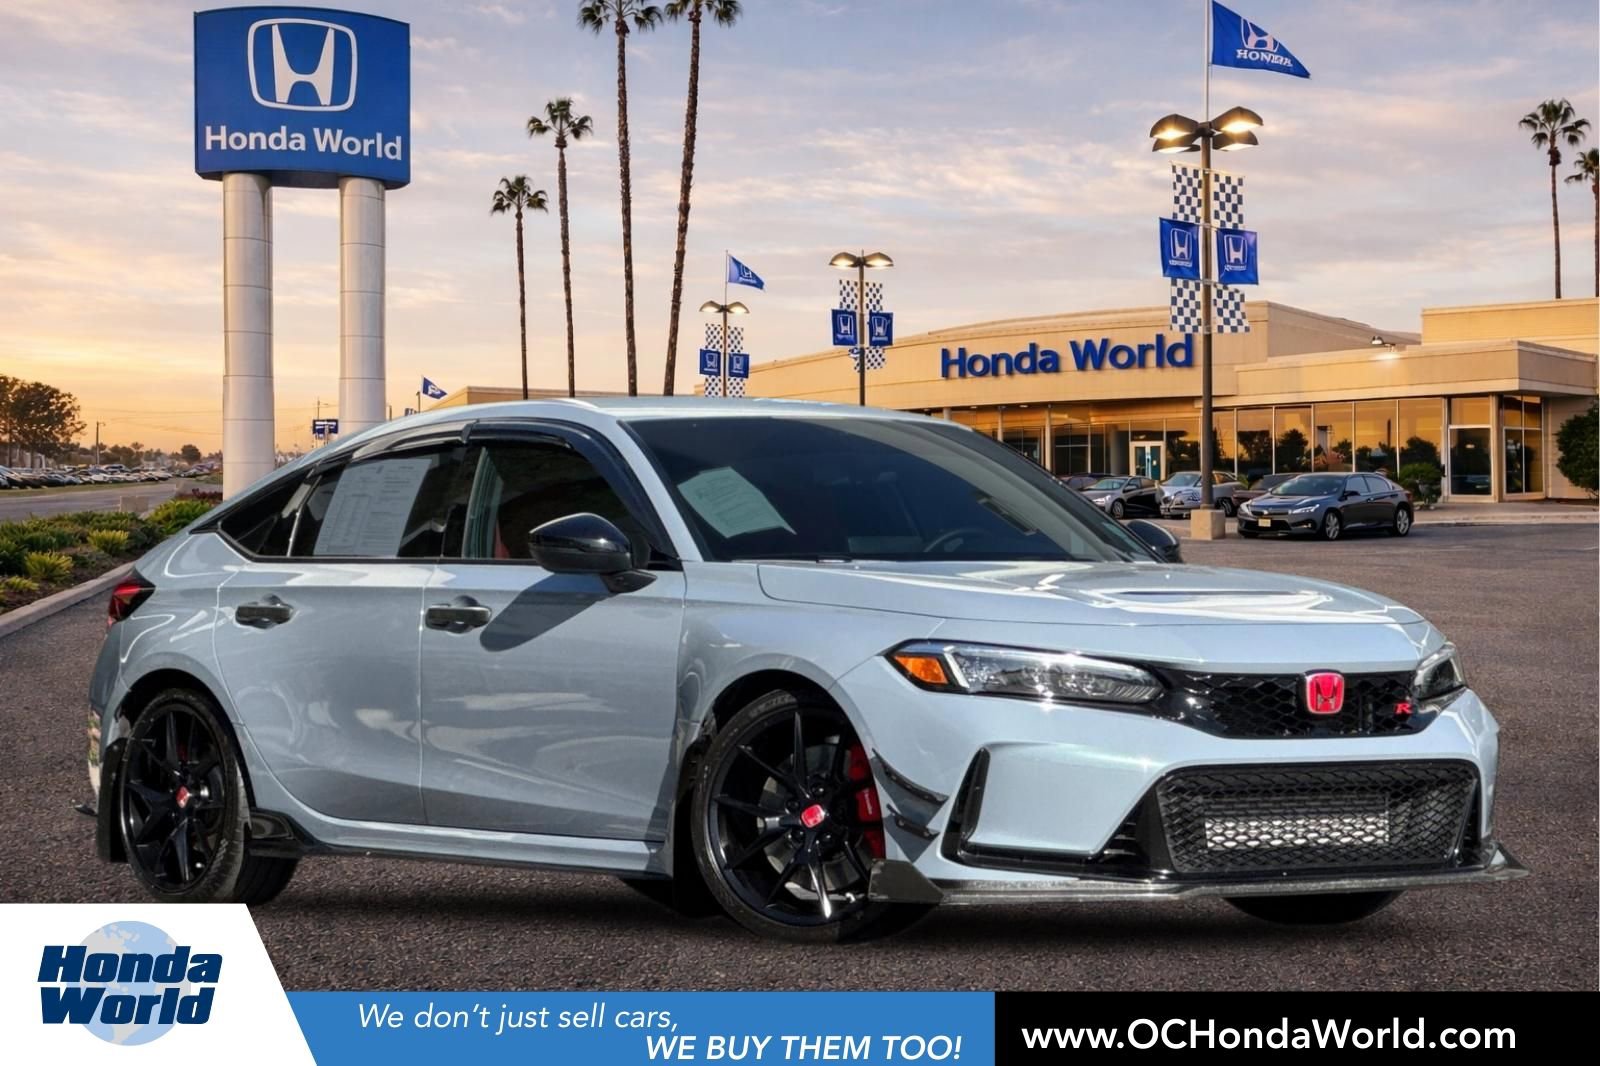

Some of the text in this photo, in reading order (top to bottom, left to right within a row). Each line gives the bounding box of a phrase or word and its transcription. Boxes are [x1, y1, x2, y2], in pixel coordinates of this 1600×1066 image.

[205, 125, 402, 161] Honda World
[941, 333, 1194, 378] Honda World
